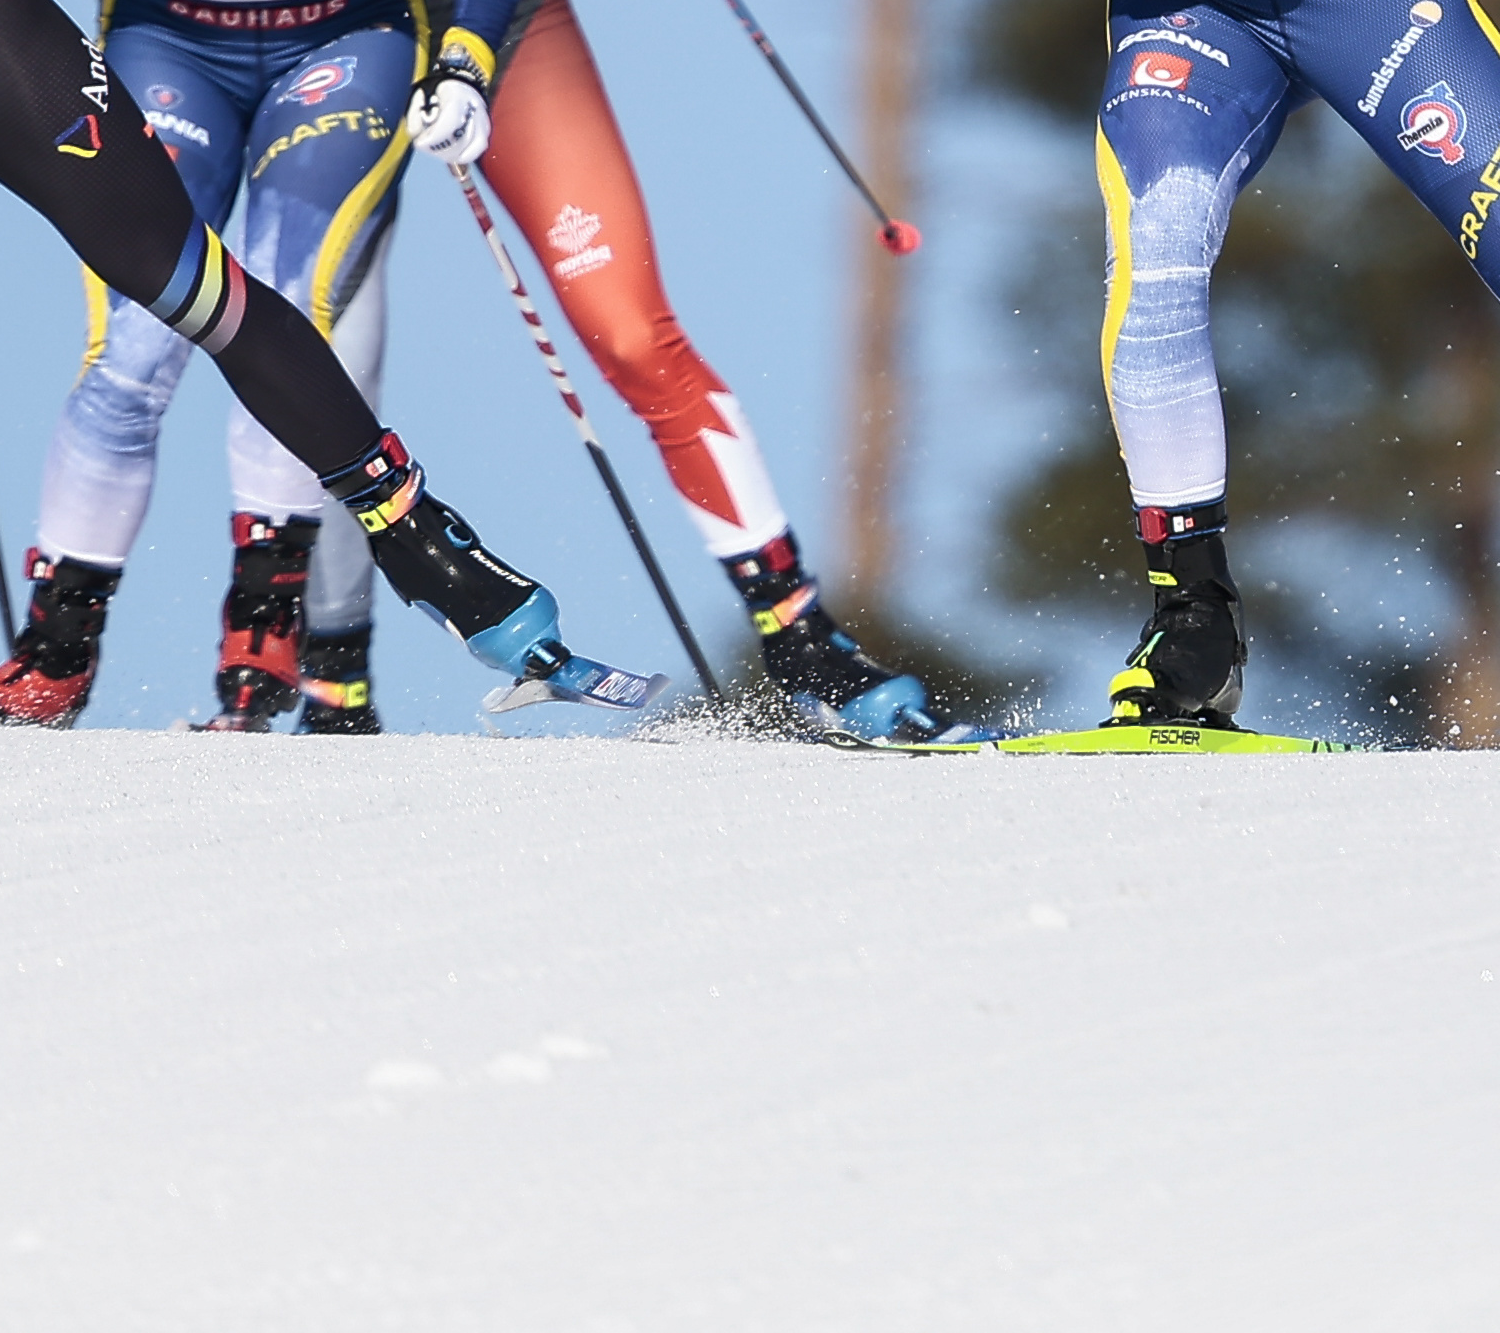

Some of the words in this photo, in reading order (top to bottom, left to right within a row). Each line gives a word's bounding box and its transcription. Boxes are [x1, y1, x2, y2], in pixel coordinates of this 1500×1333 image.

[1116, 28, 1230, 68] SCANIA
[1357, 25, 1425, 118] Sundström
[1105, 87, 1173, 112] SVENSKA
[1177, 93, 1212, 116] SPEL
[1399, 115, 1445, 151] Thermia
[1149, 728, 1201, 746] FISCHER
